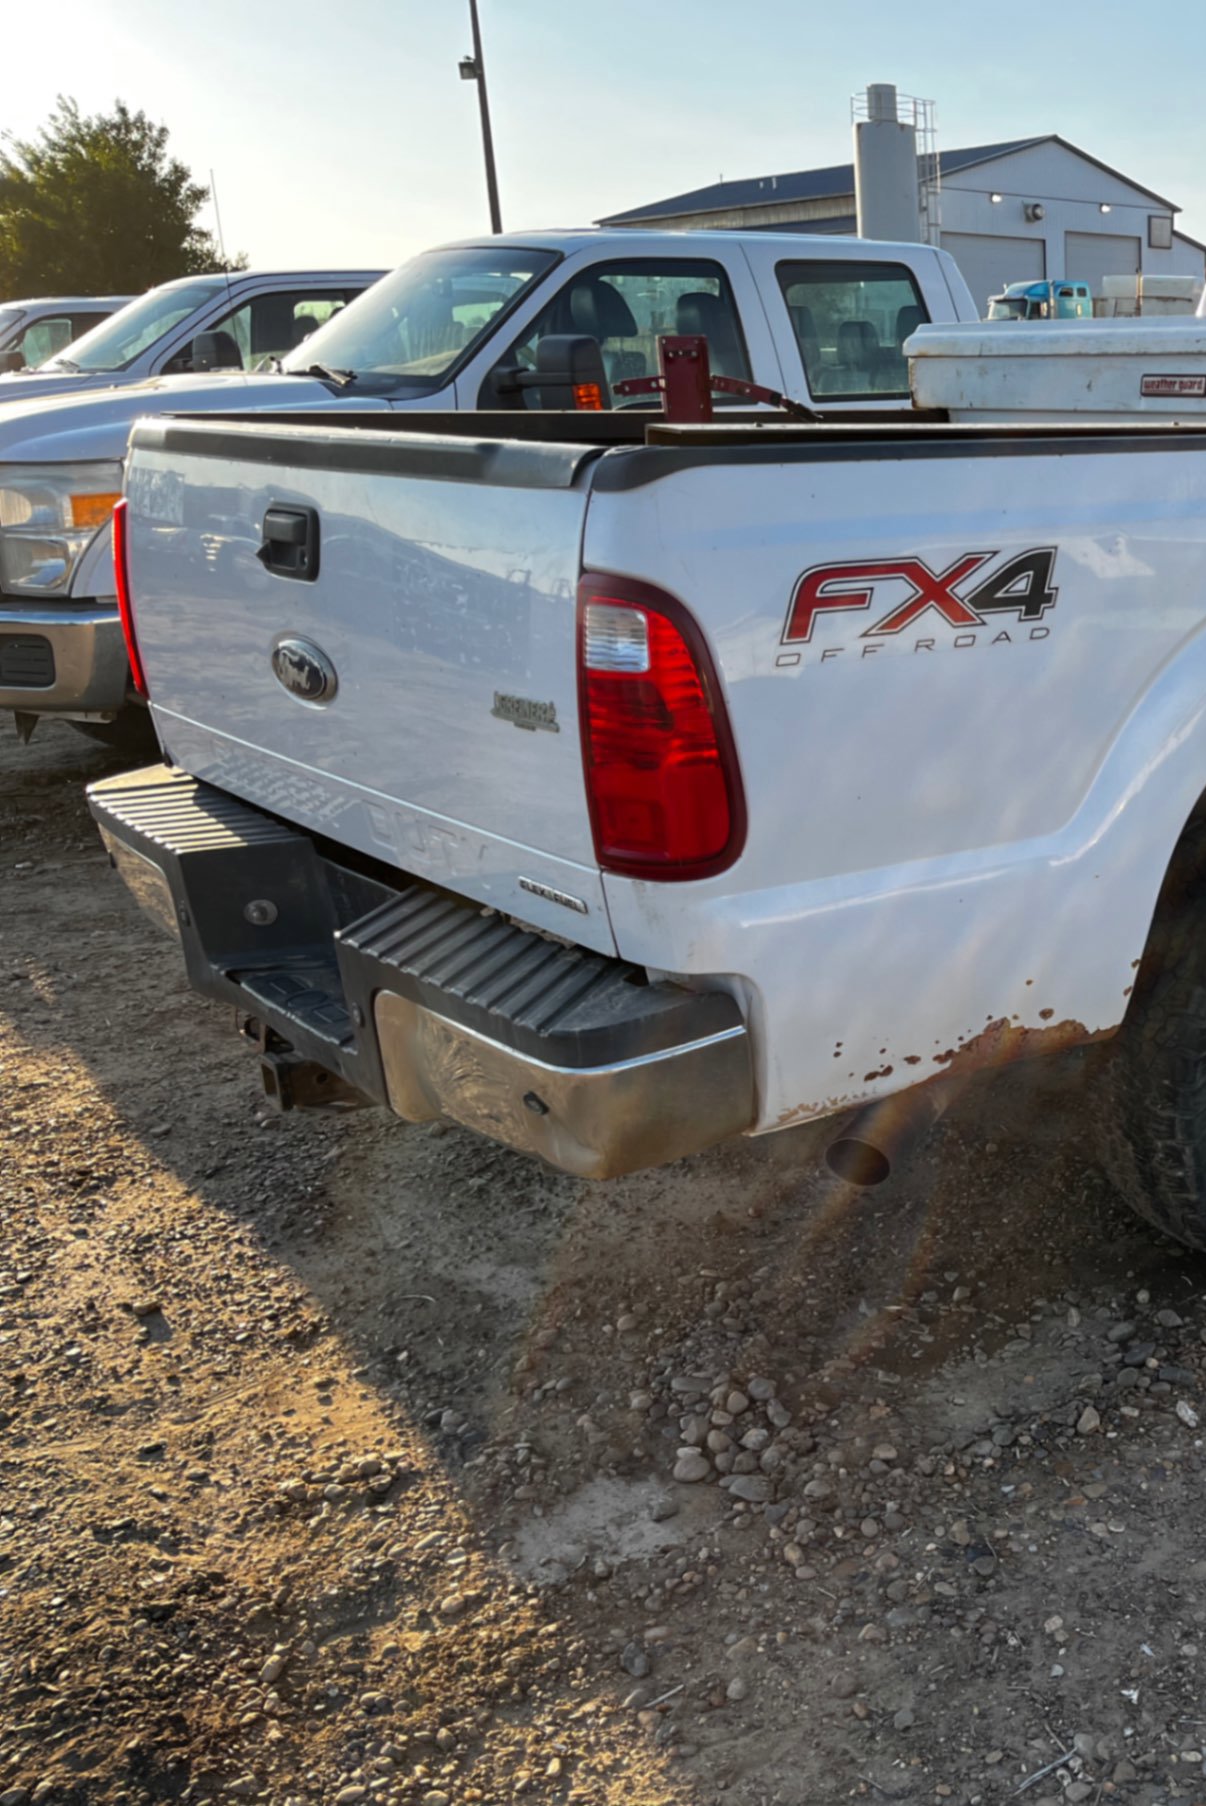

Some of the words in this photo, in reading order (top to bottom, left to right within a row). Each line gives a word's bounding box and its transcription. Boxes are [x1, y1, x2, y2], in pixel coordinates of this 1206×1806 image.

[780, 546, 1059, 645] FX4
[775, 642, 884, 667] OFF
[914, 626, 1051, 652] ROAD
